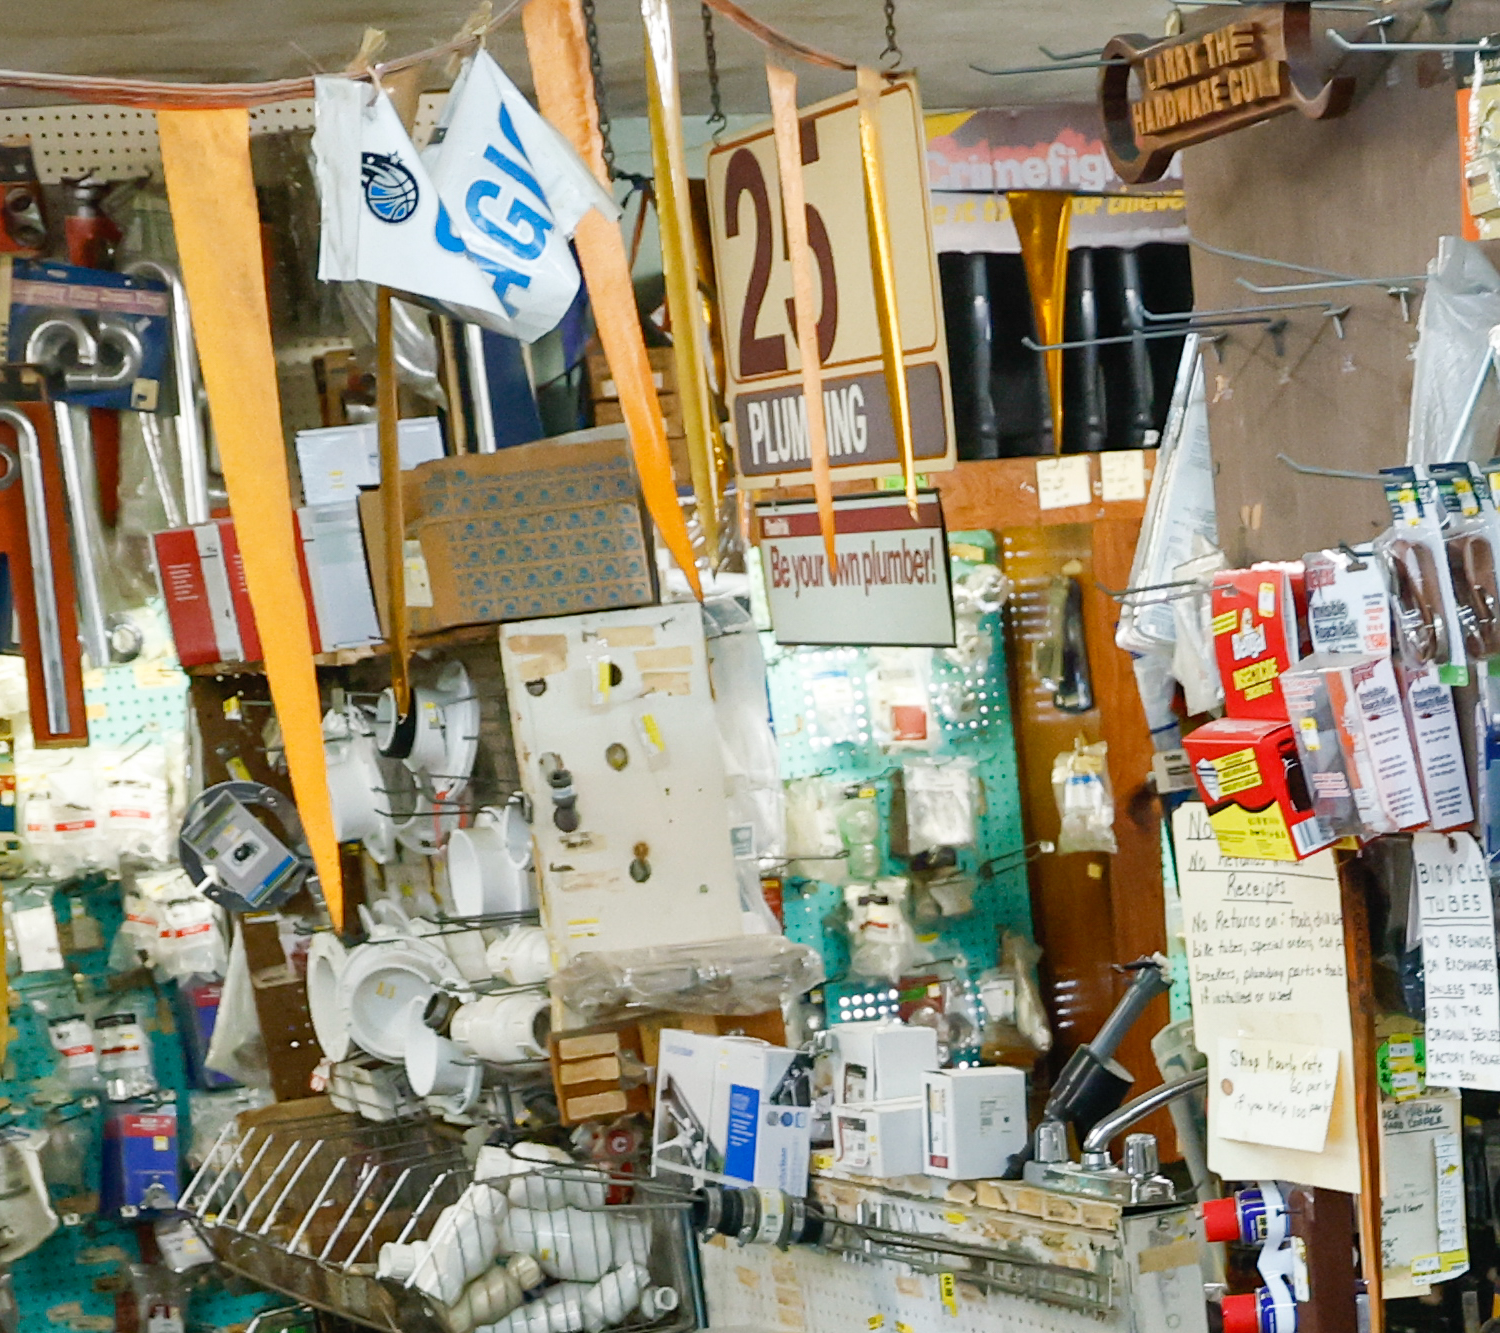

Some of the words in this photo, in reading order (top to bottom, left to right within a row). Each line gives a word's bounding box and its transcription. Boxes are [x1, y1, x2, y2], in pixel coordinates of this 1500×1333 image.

[1144, 40, 1202, 91] LARRY
[1203, 21, 1255, 68] THE
[1132, 74, 1222, 135] HARDWARE
[747, 384, 868, 466] PLUMING
[770, 545, 790, 588] Be
[794, 551, 825, 598] your
[865, 537, 938, 597] plumber!
[1418, 863, 1486, 884] BICYCLE
[1226, 873, 1287, 899] Receipts
[1424, 894, 1482, 912] TUBES
[1192, 911, 1209, 933] No
[1215, 909, 1261, 930] Returns
[1425, 936, 1440, 949] NO
[1449, 935, 1493, 950] REFUNDS
[1445, 958, 1495, 973] EXCHANGES
[1428, 984, 1465, 998] UNLESS
[1472, 983, 1494, 996] TUBE
[1461, 1005, 1482, 1018] THE
[1230, 1049, 1260, 1073] Shop
[1267, 1050, 1297, 1077] hourly
[1301, 1055, 1324, 1073] rate
[1428, 1049, 1465, 1065] FACTORY
[1305, 1083, 1322, 1097] per
[1247, 1102, 1264, 1116] you
[1267, 1100, 1289, 1118] help
